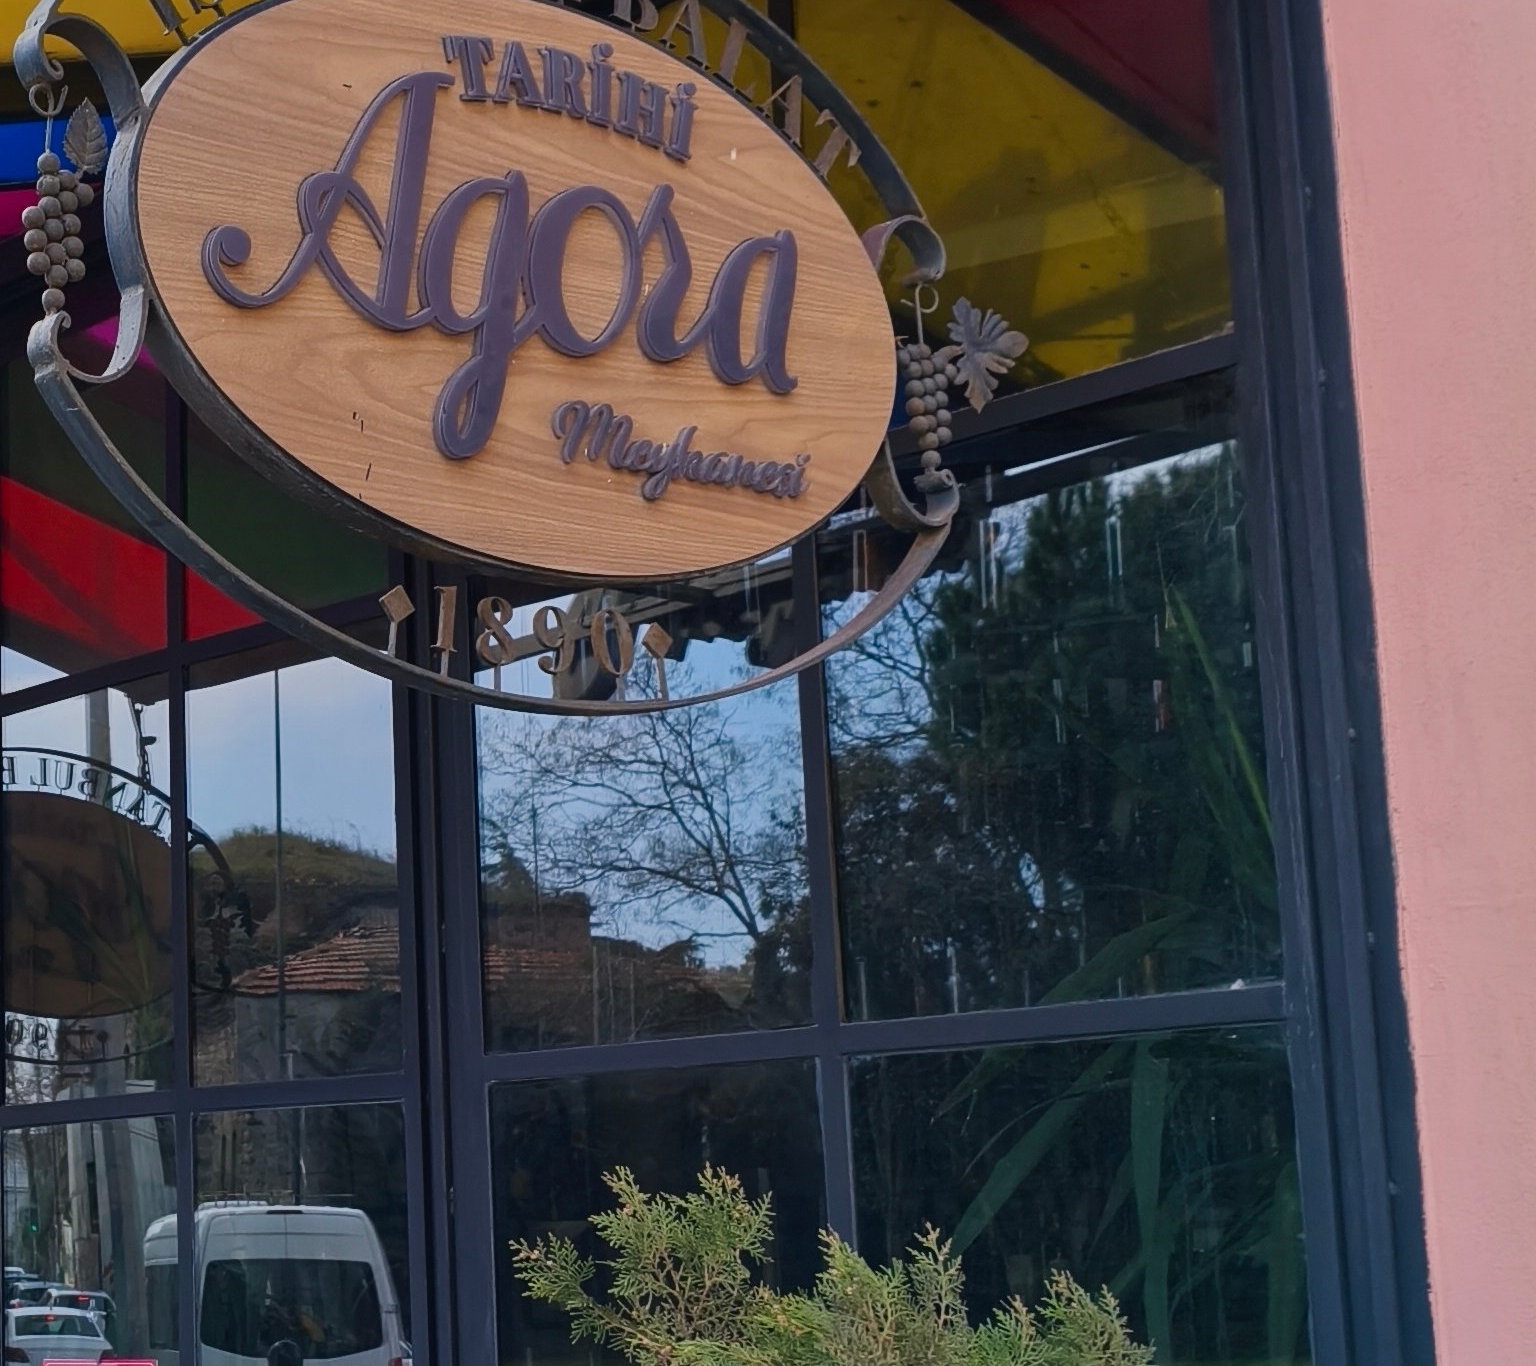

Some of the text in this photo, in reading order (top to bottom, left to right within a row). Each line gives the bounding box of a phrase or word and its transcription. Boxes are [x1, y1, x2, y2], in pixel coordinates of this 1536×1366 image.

[440, 33, 701, 165] TARİHİ
[201, 69, 801, 462] Agora
[551, 398, 813, 502] Meyhanesi
[430, 585, 634, 678] 1890
